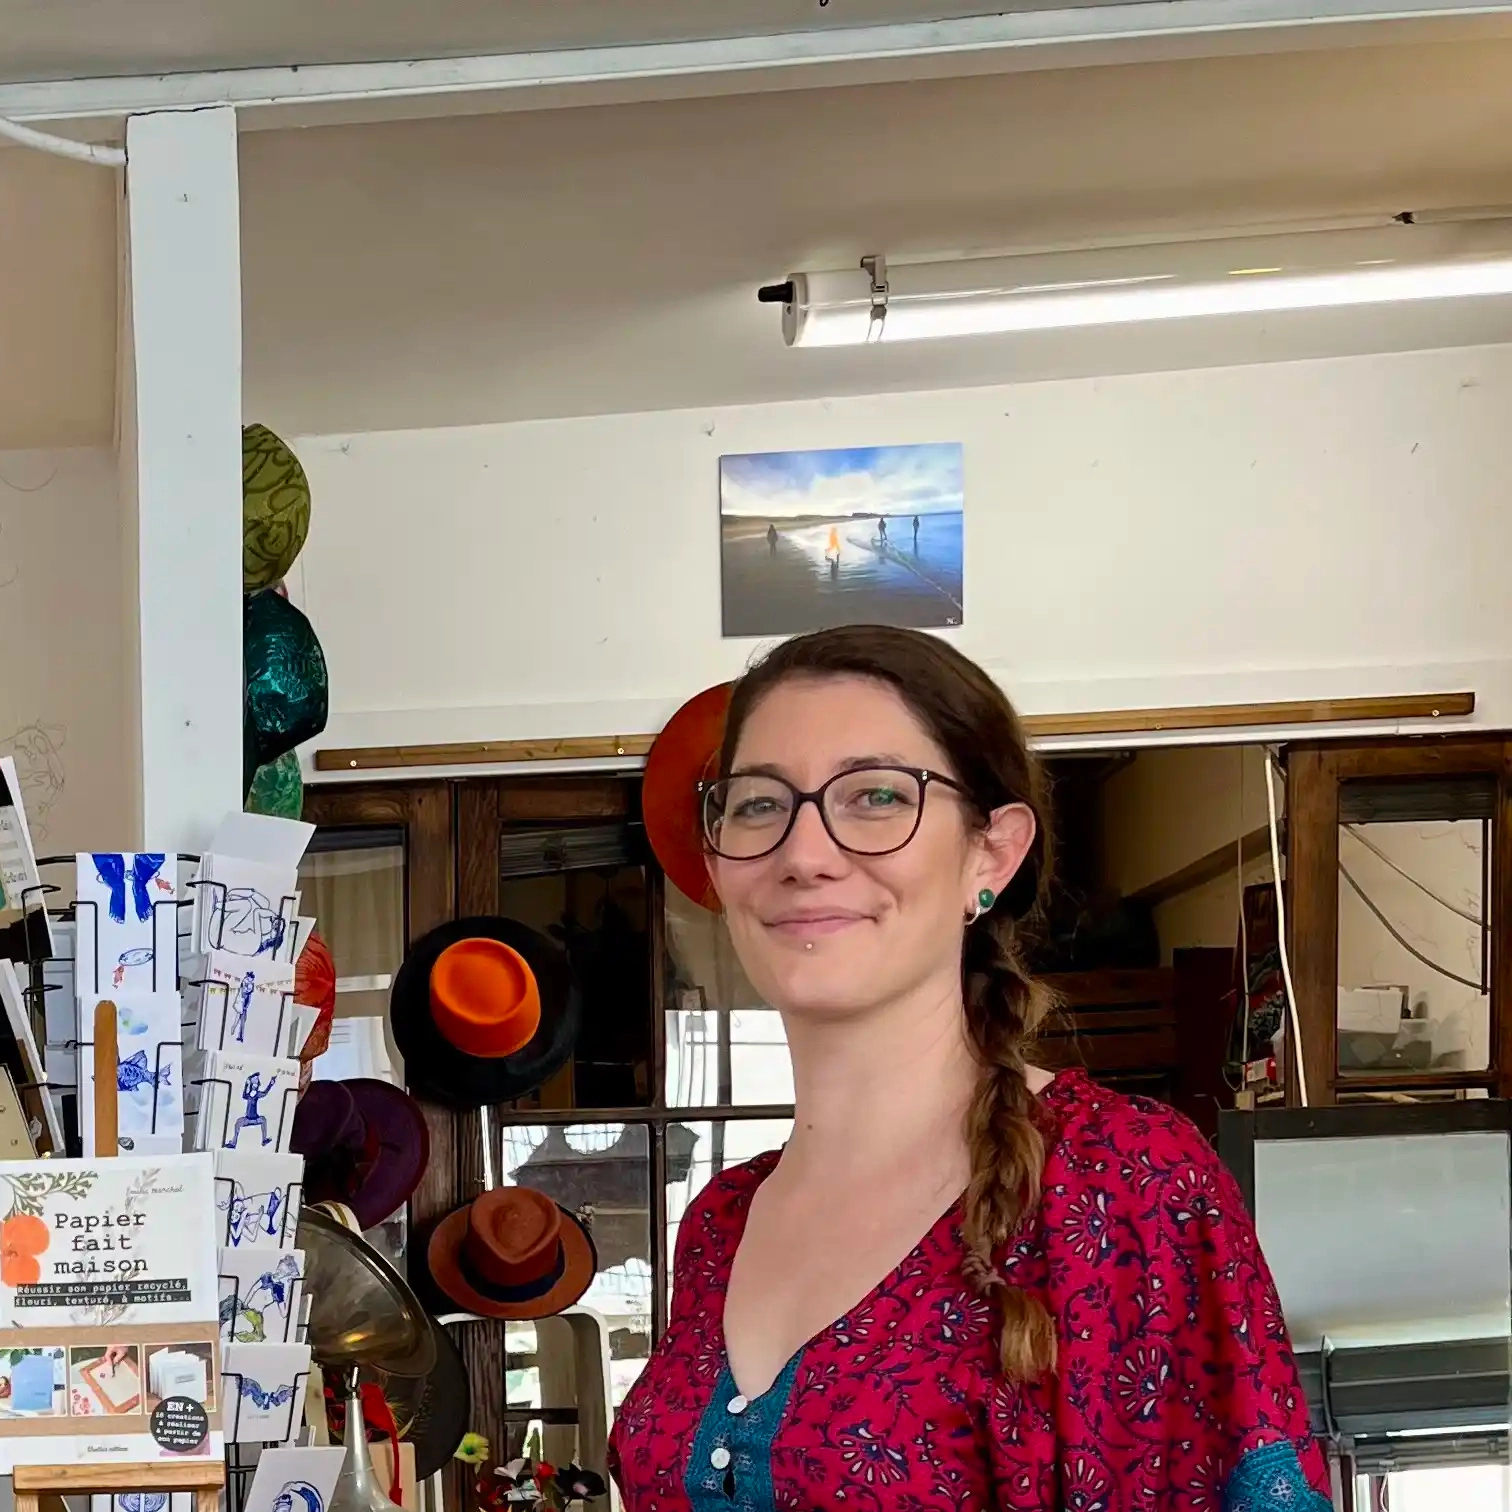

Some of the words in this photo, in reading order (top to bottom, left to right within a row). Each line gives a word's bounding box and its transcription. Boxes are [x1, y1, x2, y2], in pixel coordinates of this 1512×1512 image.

[54, 1210, 146, 1233] Papier
[71, 1234, 133, 1252] fait
[53, 1256, 149, 1275] maison
[17, 1284, 61, 1295] Réussir
[68, 1285, 87, 1294] son
[93, 1283, 131, 1294] papier
[166, 1401, 184, 1412] EN
